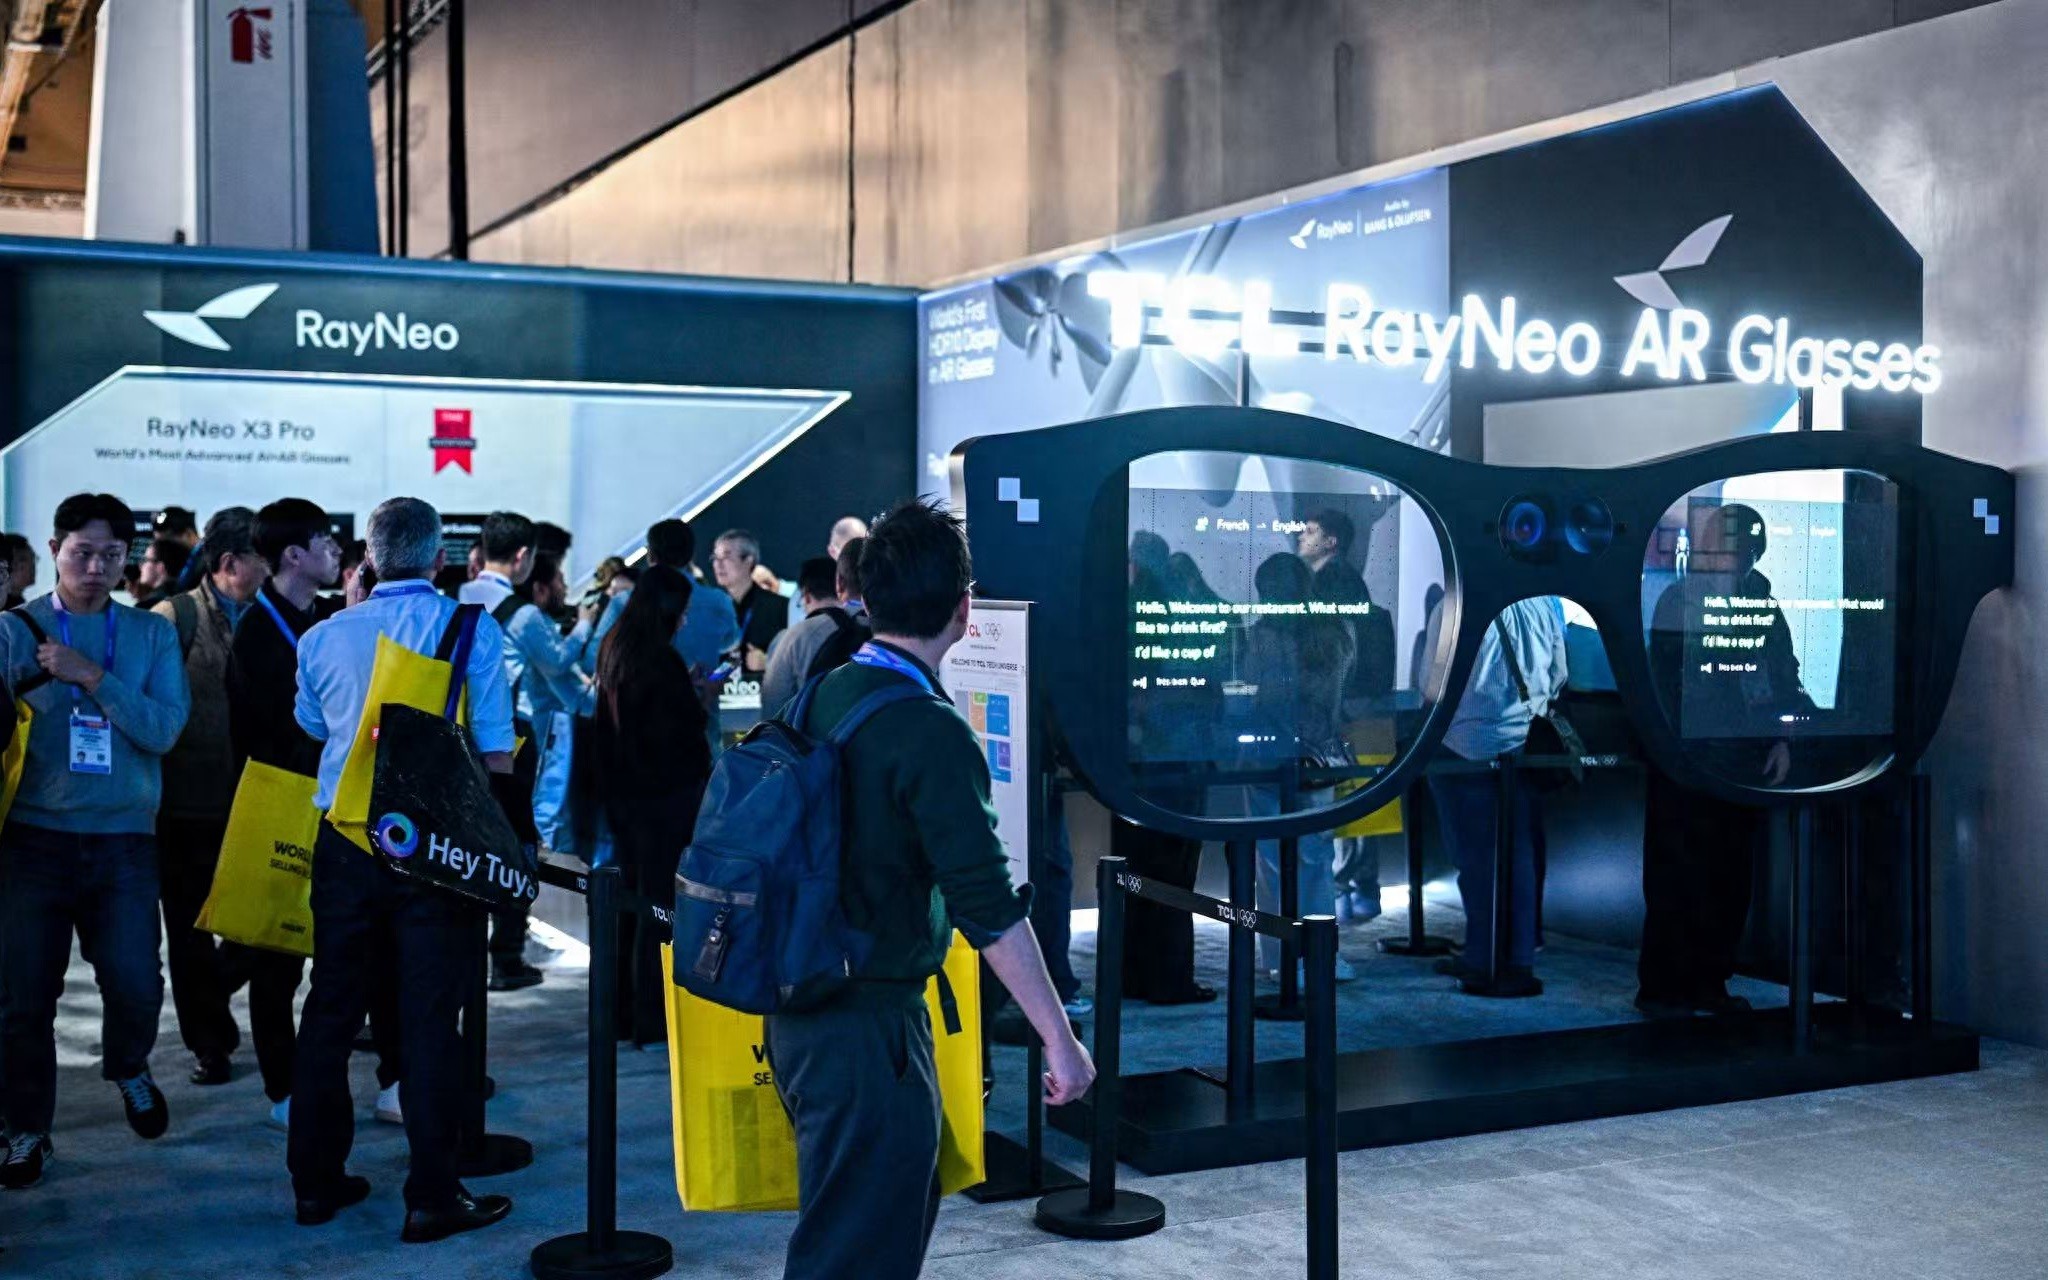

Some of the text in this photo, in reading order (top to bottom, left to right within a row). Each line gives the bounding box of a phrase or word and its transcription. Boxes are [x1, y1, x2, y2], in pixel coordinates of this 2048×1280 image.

[1316, 219, 1354, 241] RayNeo
[295, 308, 460, 357] RayNeo
[1086, 270, 1945, 395] TCL RayNeo AR Glasses
[146, 416, 316, 442] RayNeo X3 Pro
[93, 446, 145, 460] World's
[1216, 518, 1307, 535] French English
[1136, 601, 1370, 615] Hello, Welcome to our restaurant. What would
[1729, 596, 1767, 609] Welcome
[1135, 621, 1228, 635] like to drink first?
[1730, 613, 1753, 626] drink
[967, 624, 982, 639] CL
[1134, 644, 1217, 661] I'd like a cup of
[1580, 756, 1598, 766] TCL
[428, 832, 482, 881] Hey
[652, 905, 669, 922] TCL
[1216, 904, 1236, 922] TCL
